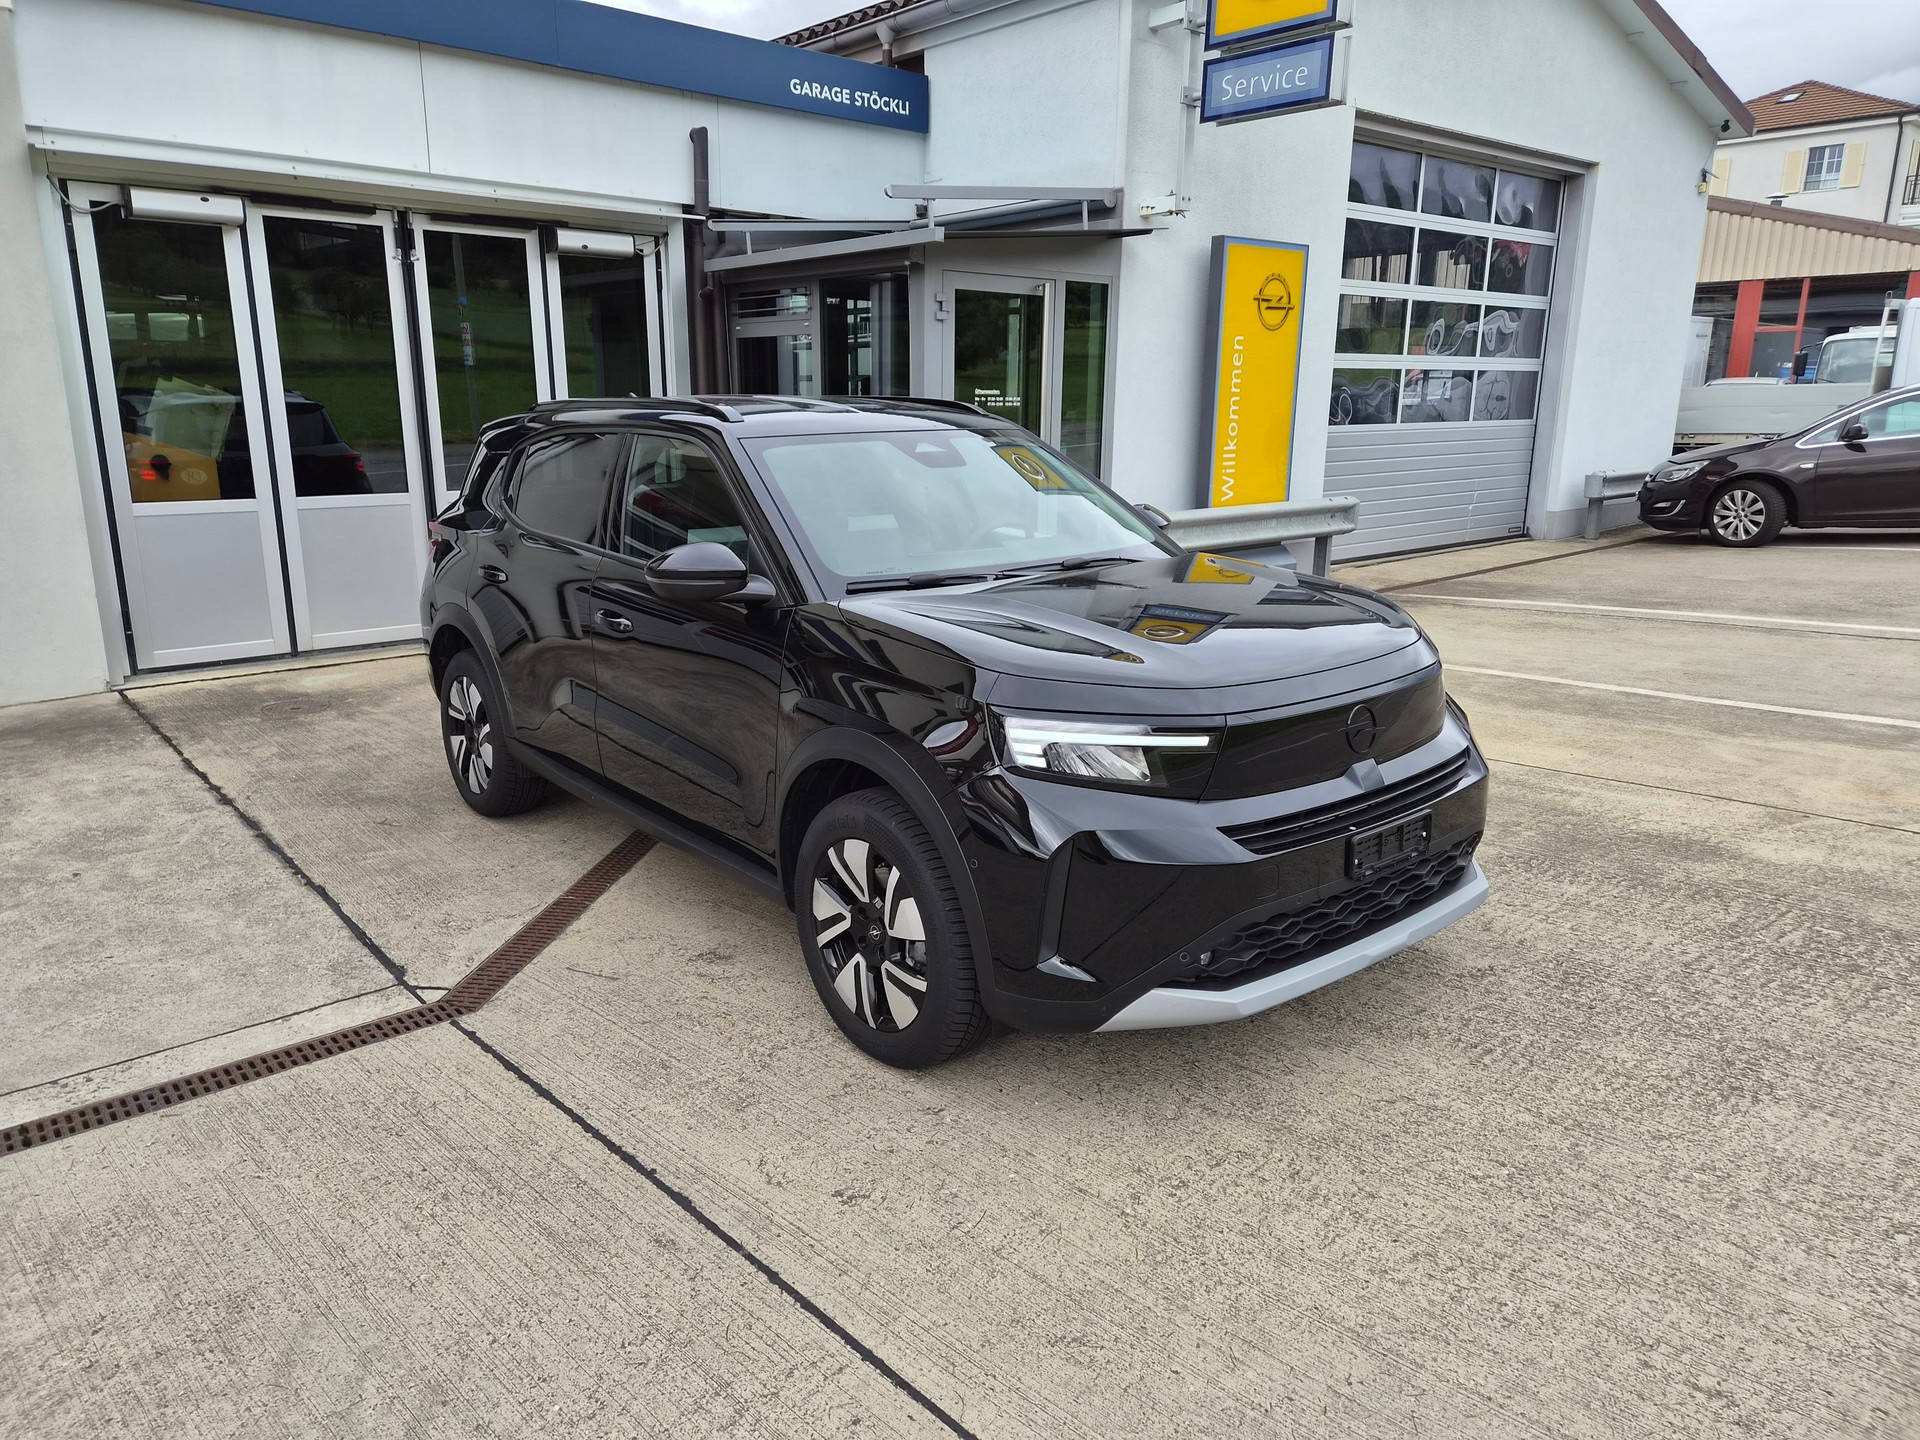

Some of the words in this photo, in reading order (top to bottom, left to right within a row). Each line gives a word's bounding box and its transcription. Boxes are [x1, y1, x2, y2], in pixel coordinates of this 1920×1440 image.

[790, 78, 850, 104] GARAGE
[854, 90, 909, 116] STÖCKLI
[1221, 63, 1308, 101] Service
[1220, 334, 1245, 502] Willkommen
